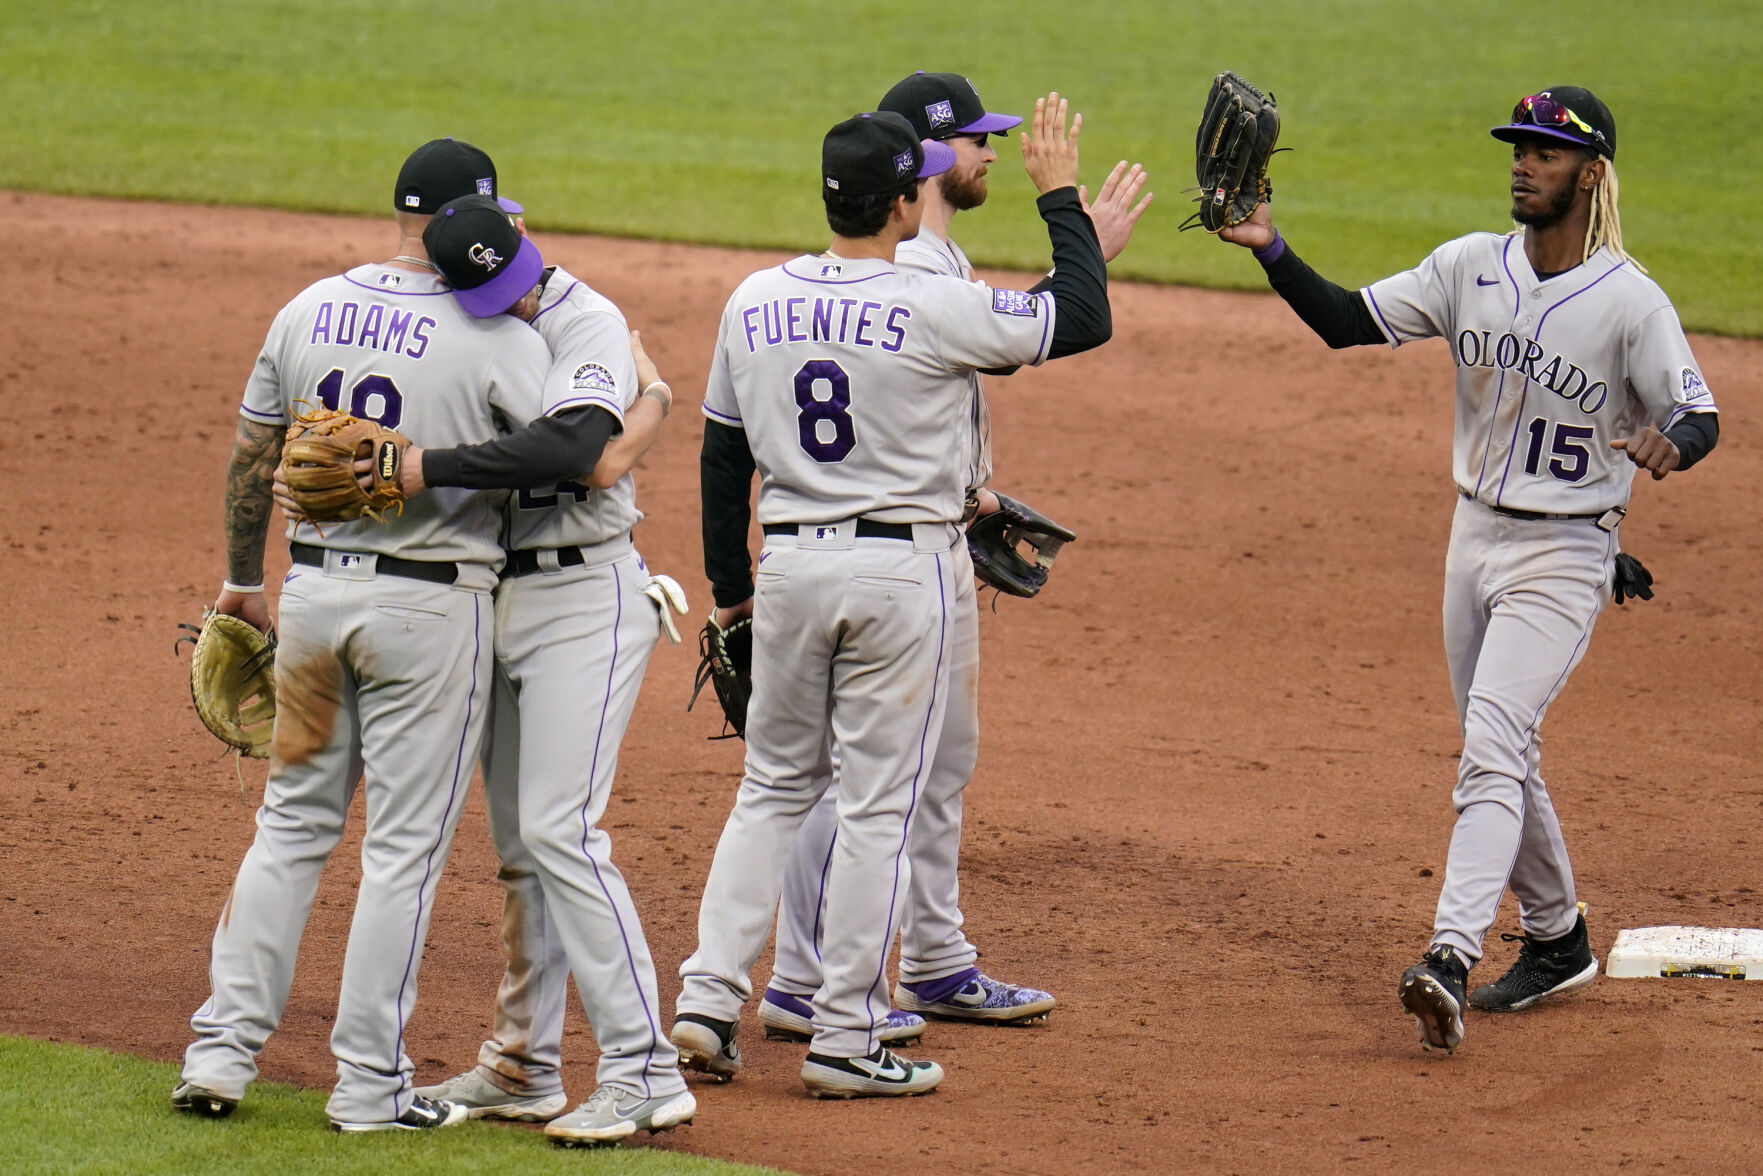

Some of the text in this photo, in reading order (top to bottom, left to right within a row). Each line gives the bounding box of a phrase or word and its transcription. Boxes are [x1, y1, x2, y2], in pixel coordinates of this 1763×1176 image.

[931, 108, 952, 122] ASG
[898, 156, 913, 171] ASG
[468, 242, 504, 272] CR
[309, 300, 438, 361] ADAMS
[742, 296, 913, 354] FUENTES
[1457, 329, 1608, 415] OLORADO
[793, 357, 859, 465] 8
[383, 442, 394, 478] Wilson
[1523, 416, 1596, 484] 15
